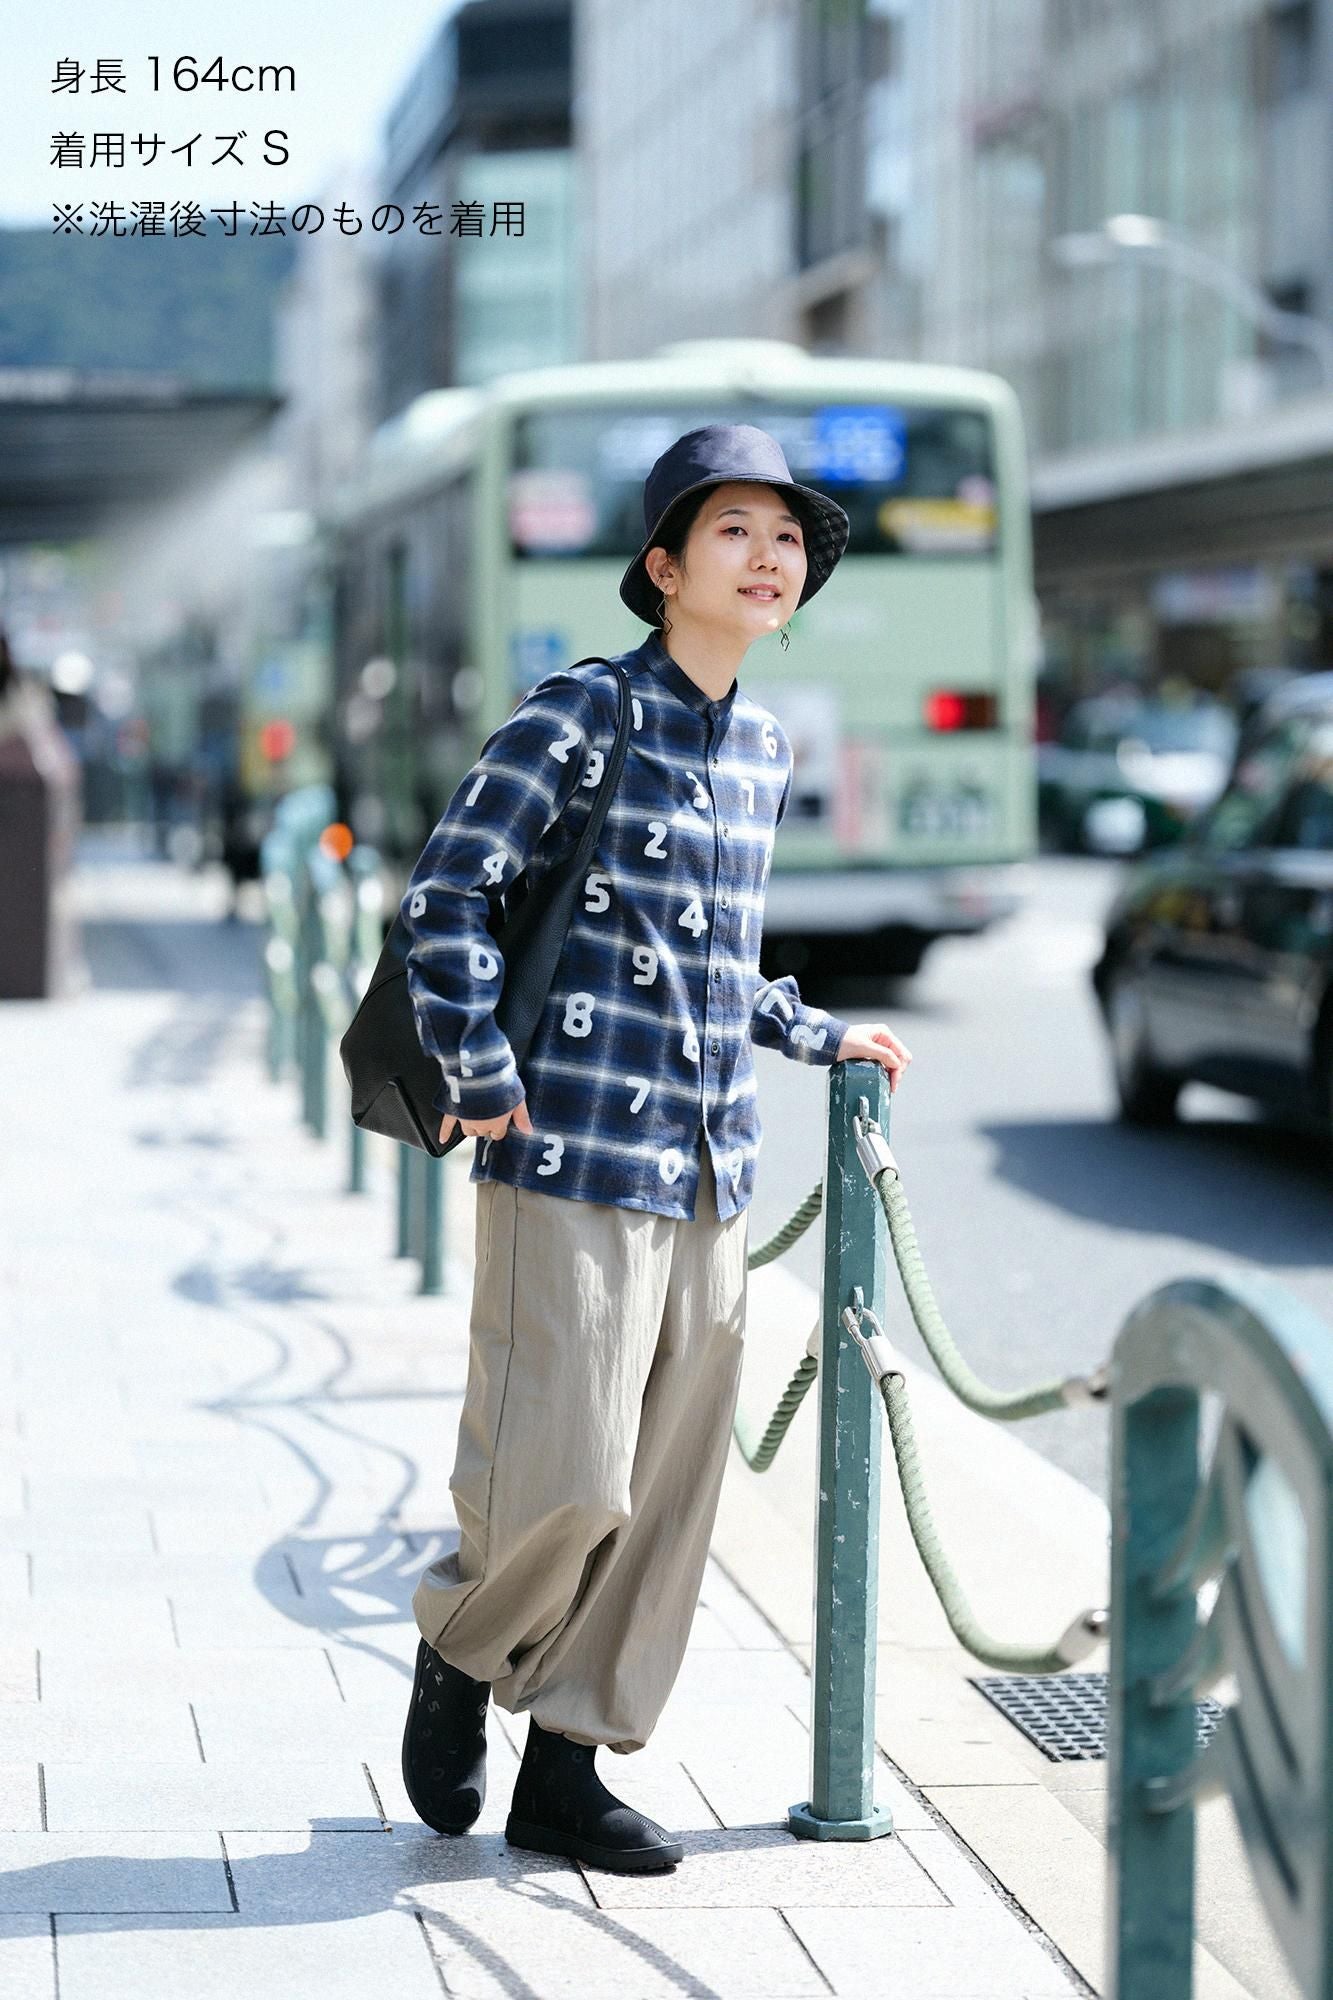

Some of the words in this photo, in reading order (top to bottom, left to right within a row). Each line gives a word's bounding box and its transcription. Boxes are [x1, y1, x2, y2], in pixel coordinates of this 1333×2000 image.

[548, 722, 582, 764] 2
[761, 721, 777, 759] 6
[644, 821, 667, 859] 2
[482, 850, 508, 886] 4
[584, 873, 612, 914] 5
[678, 899, 709, 938] 4
[468, 943, 498, 981] 0
[632, 945, 659, 986] 9
[562, 992, 595, 1038] 8
[625, 1076, 651, 1114] 7
[536, 1134, 565, 1176] 3
[658, 1148, 685, 1186] 0
